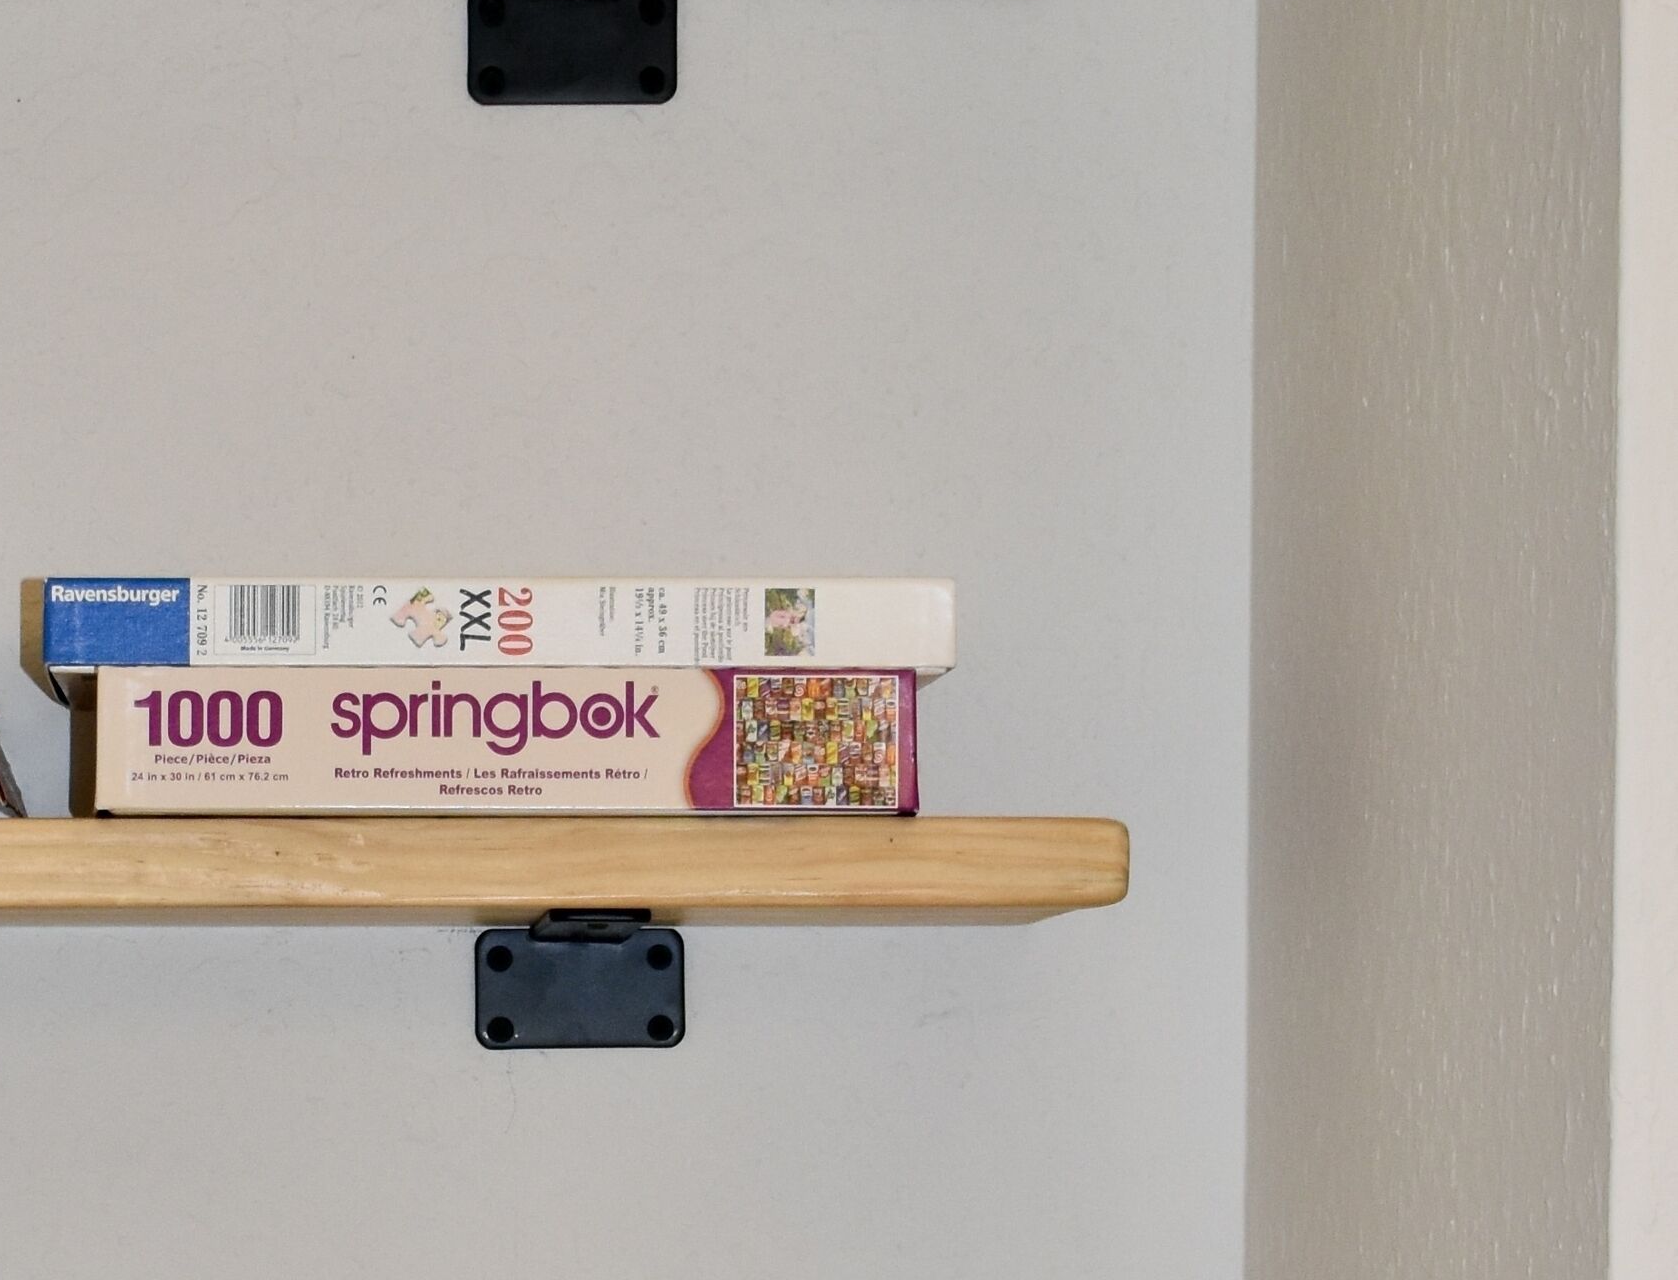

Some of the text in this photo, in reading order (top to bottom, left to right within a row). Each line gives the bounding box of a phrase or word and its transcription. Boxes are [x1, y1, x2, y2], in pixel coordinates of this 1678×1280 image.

[51, 585, 180, 606] Ravensburger
[196, 584, 208, 603] No.
[646, 587, 655, 622] approx.
[196, 609, 208, 623] 12
[460, 588, 492, 651] XXL
[497, 586, 534, 656] 200
[196, 626, 208, 646] 709
[658, 640, 665, 654] cm
[133, 690, 283, 748] 1000
[331, 680, 660, 756] springbok
[132, 772, 146, 782] 24
[148, 772, 157, 781] in
[170, 772, 182, 782] 30
[184, 772, 195, 781] in
[204, 772, 216, 782] 61
[220, 774, 236, 782] cm
[248, 772, 270, 782] 76.2
[273, 774, 289, 782] cm
[334, 768, 370, 780] Retro
[373, 768, 462, 780] Refreshments
[474, 768, 496, 780] Les
[605, 767, 640, 780] Rétro
[439, 784, 543, 796] Refrescos Retro
